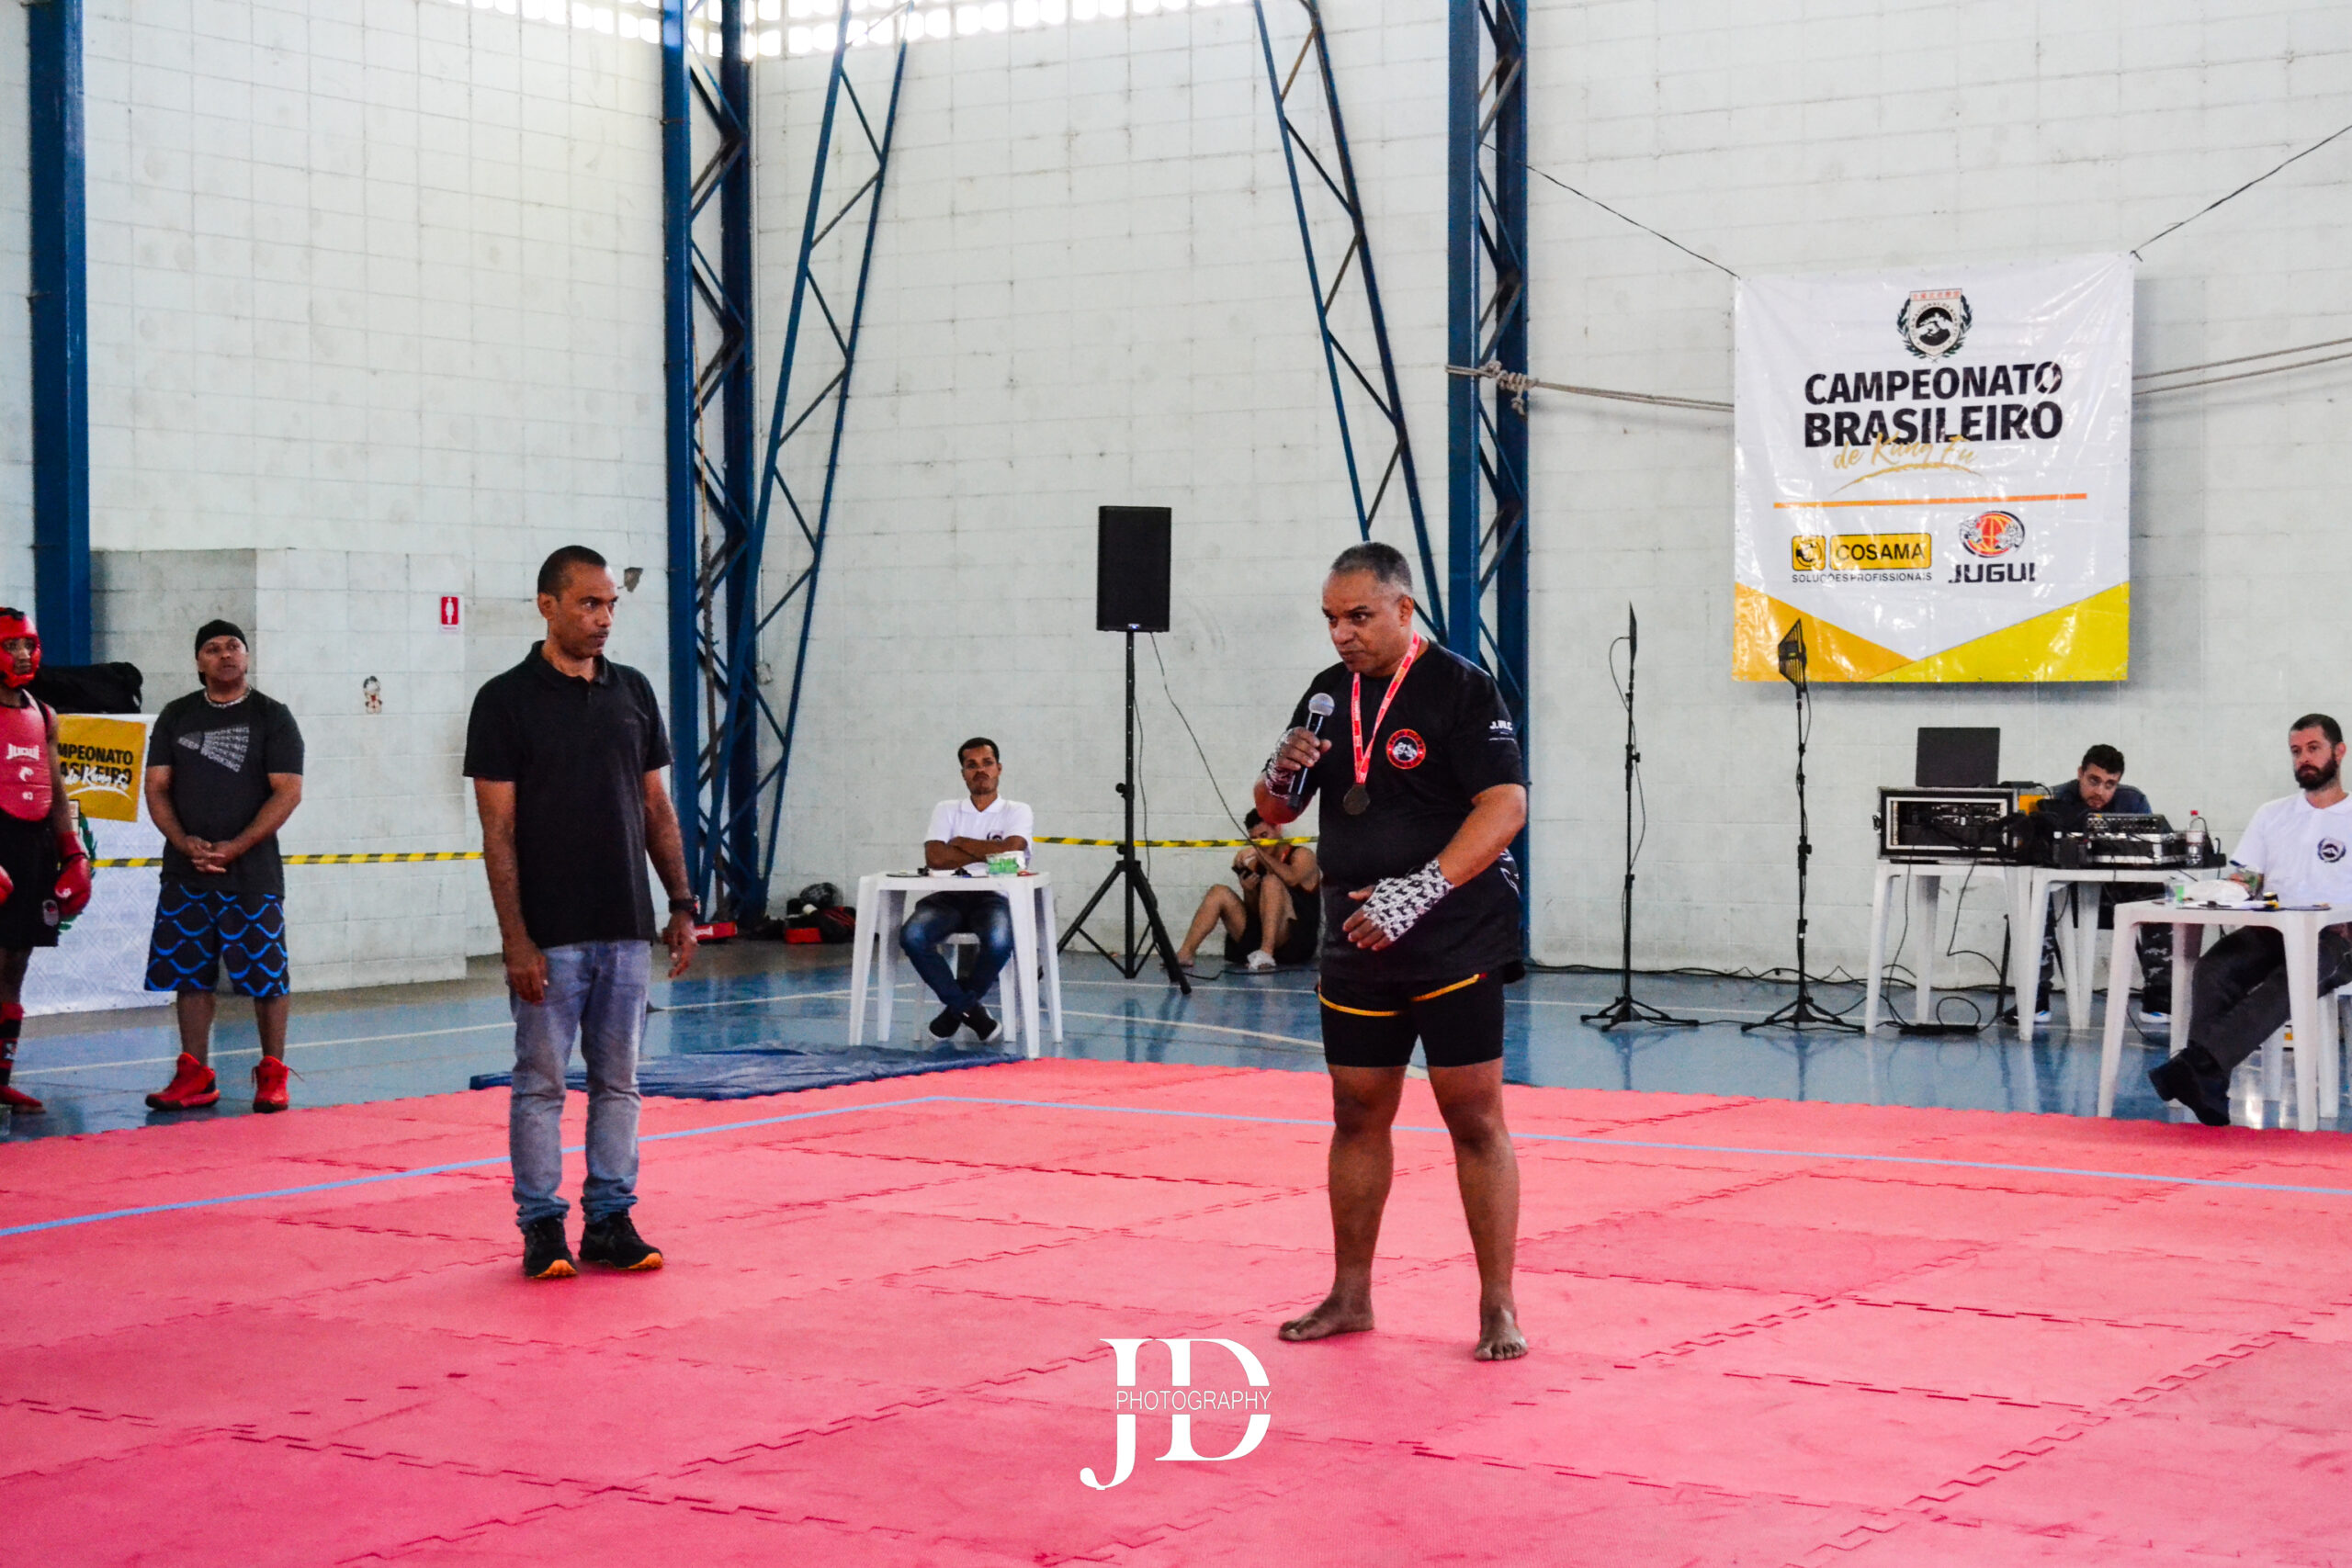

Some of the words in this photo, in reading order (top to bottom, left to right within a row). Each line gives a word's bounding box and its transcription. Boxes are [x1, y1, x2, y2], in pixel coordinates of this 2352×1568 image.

[1804, 361, 2063, 404] CAMPEONATO
[1804, 401, 2063, 447] BRASILEIRO
[1833, 441, 1863, 468] de
[1871, 431, 1933, 465] Kung
[1837, 543, 1926, 561] COSAMA
[57, 743, 134, 765] MPEONATO
